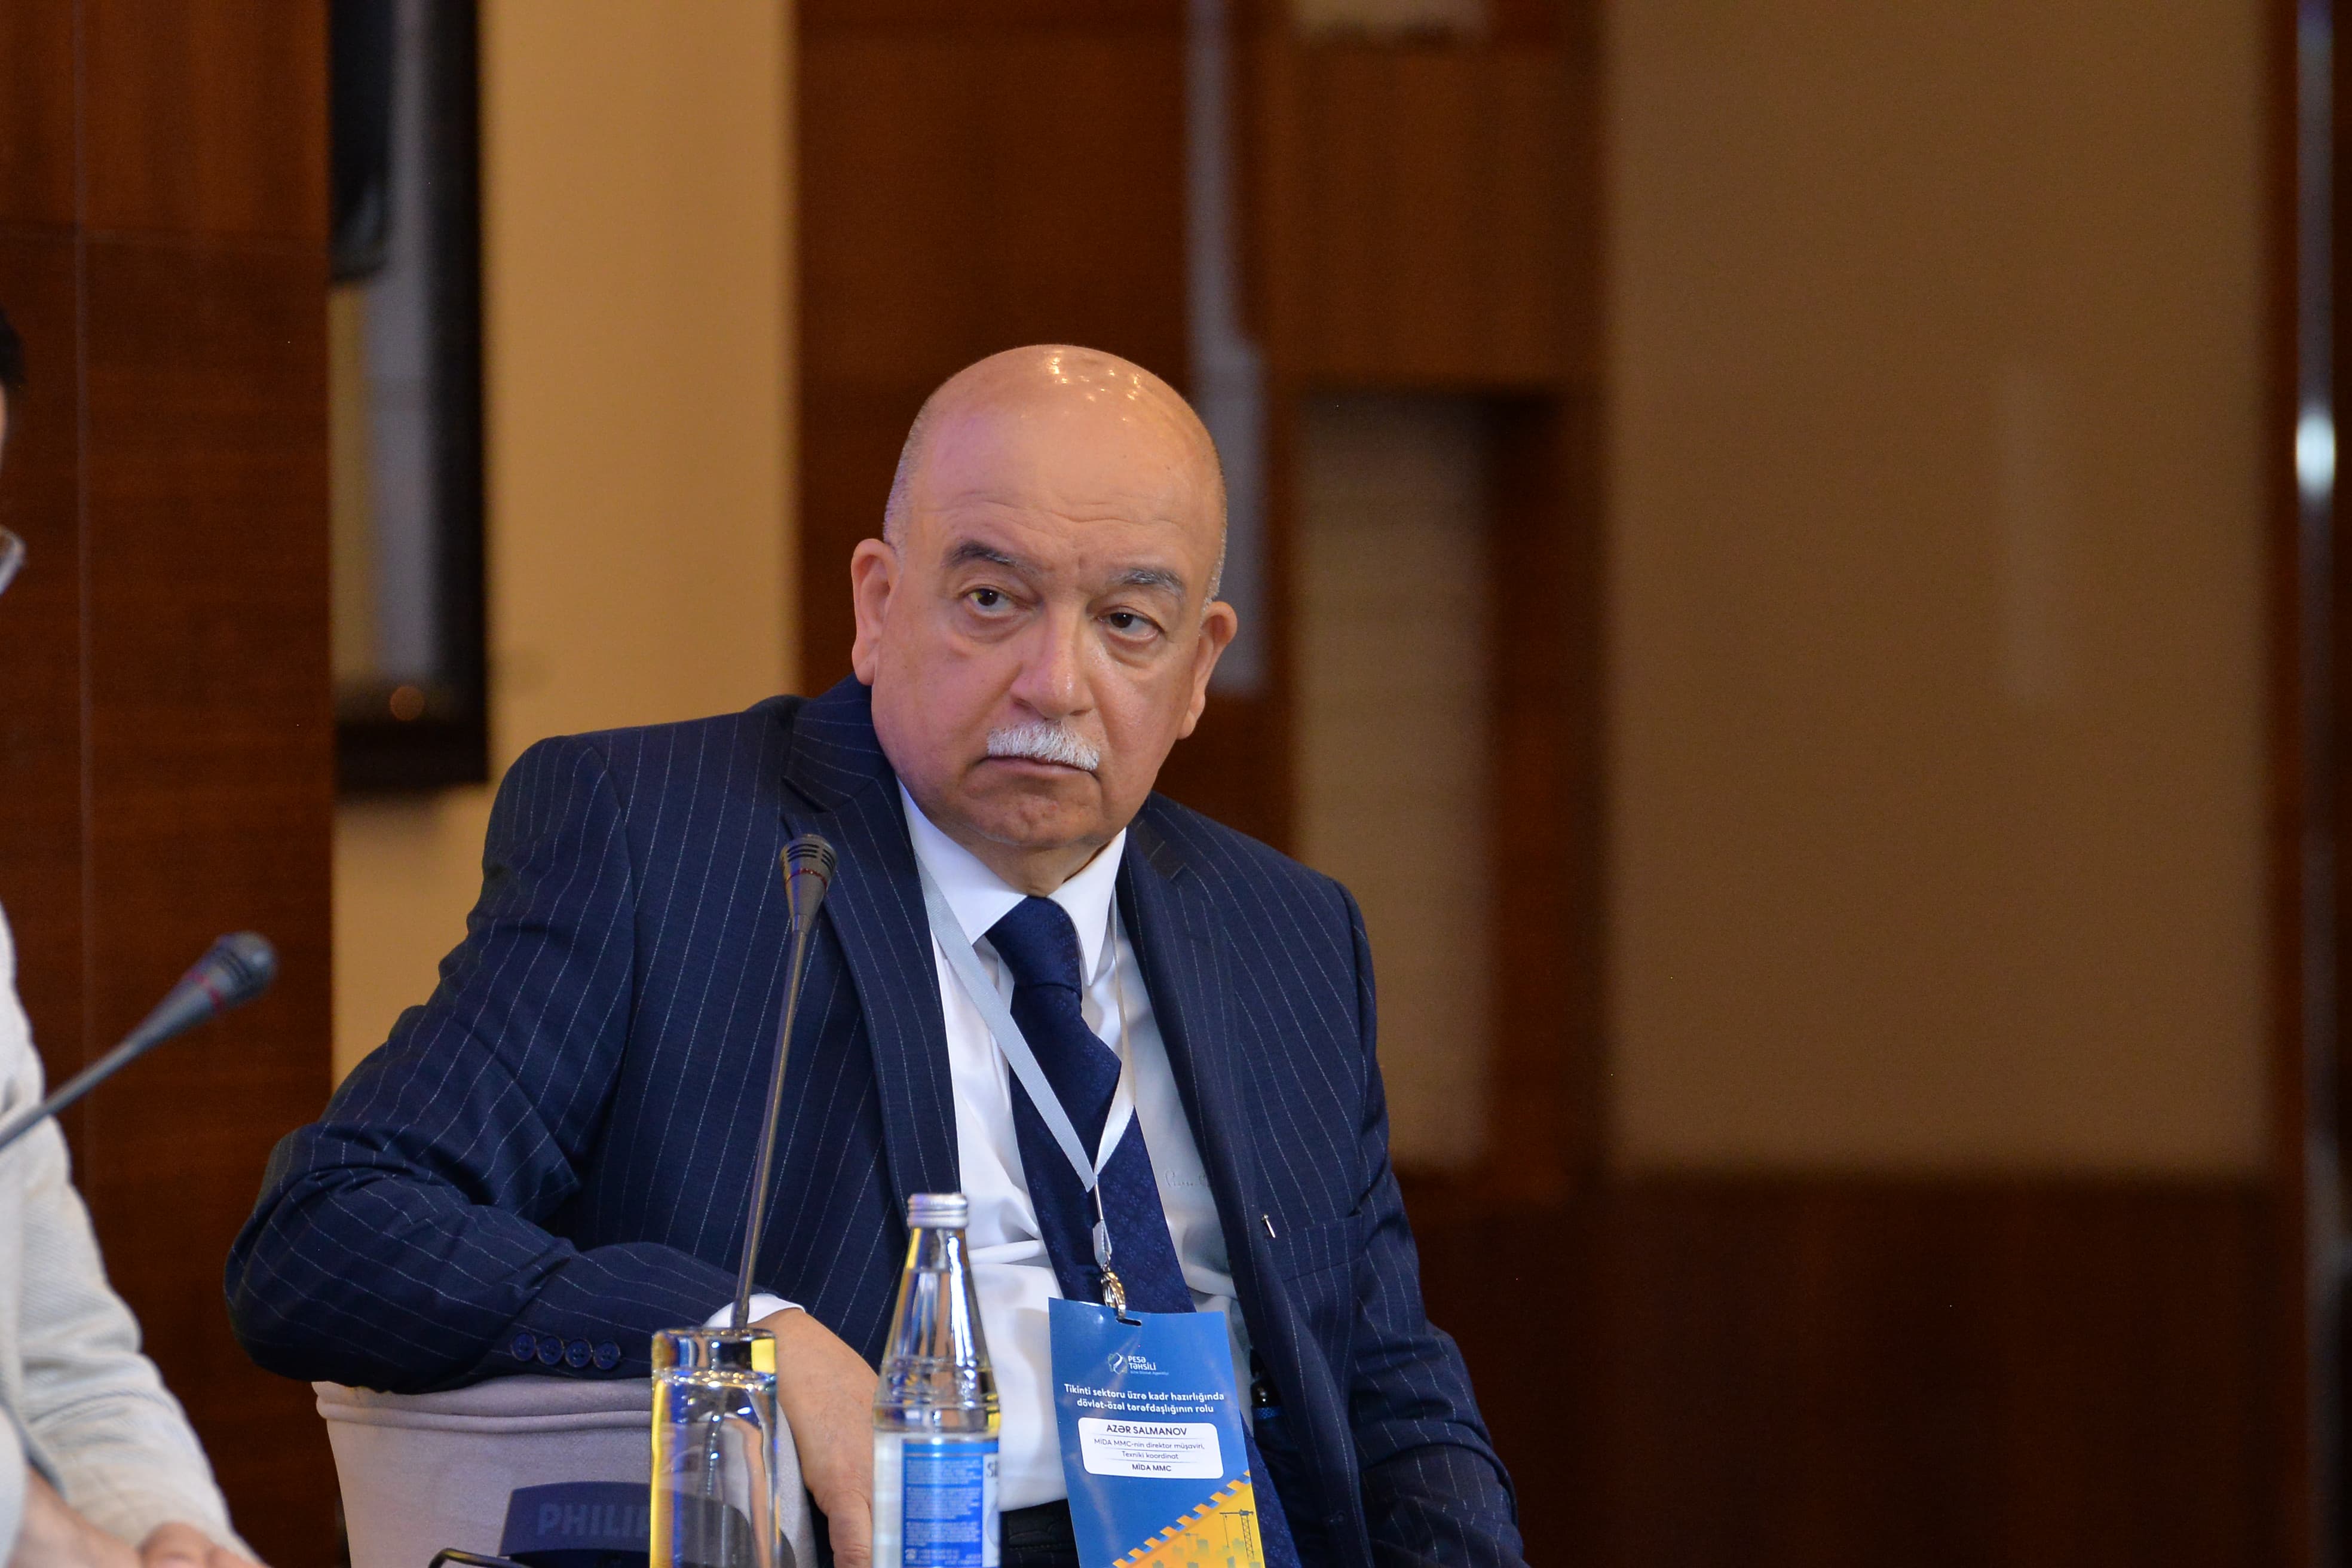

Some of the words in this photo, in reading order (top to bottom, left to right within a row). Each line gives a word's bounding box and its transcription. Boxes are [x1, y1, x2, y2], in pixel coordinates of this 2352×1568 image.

[1064, 1383, 1091, 1395] Tikinti
[1092, 1388, 1125, 1398] sektoru
[1148, 1391, 1169, 1401] kadr
[1170, 1392, 1224, 1403] hazırlığında
[1195, 1404, 1214, 1413] rolu
[1106, 1424, 1131, 1434] AZƏR
[1133, 1426, 1187, 1435] SALMANOV
[1113, 1440, 1144, 1448] MMC-nin
[1122, 1450, 1144, 1459] Texniki
[537, 1502, 650, 1538] PHILIP
